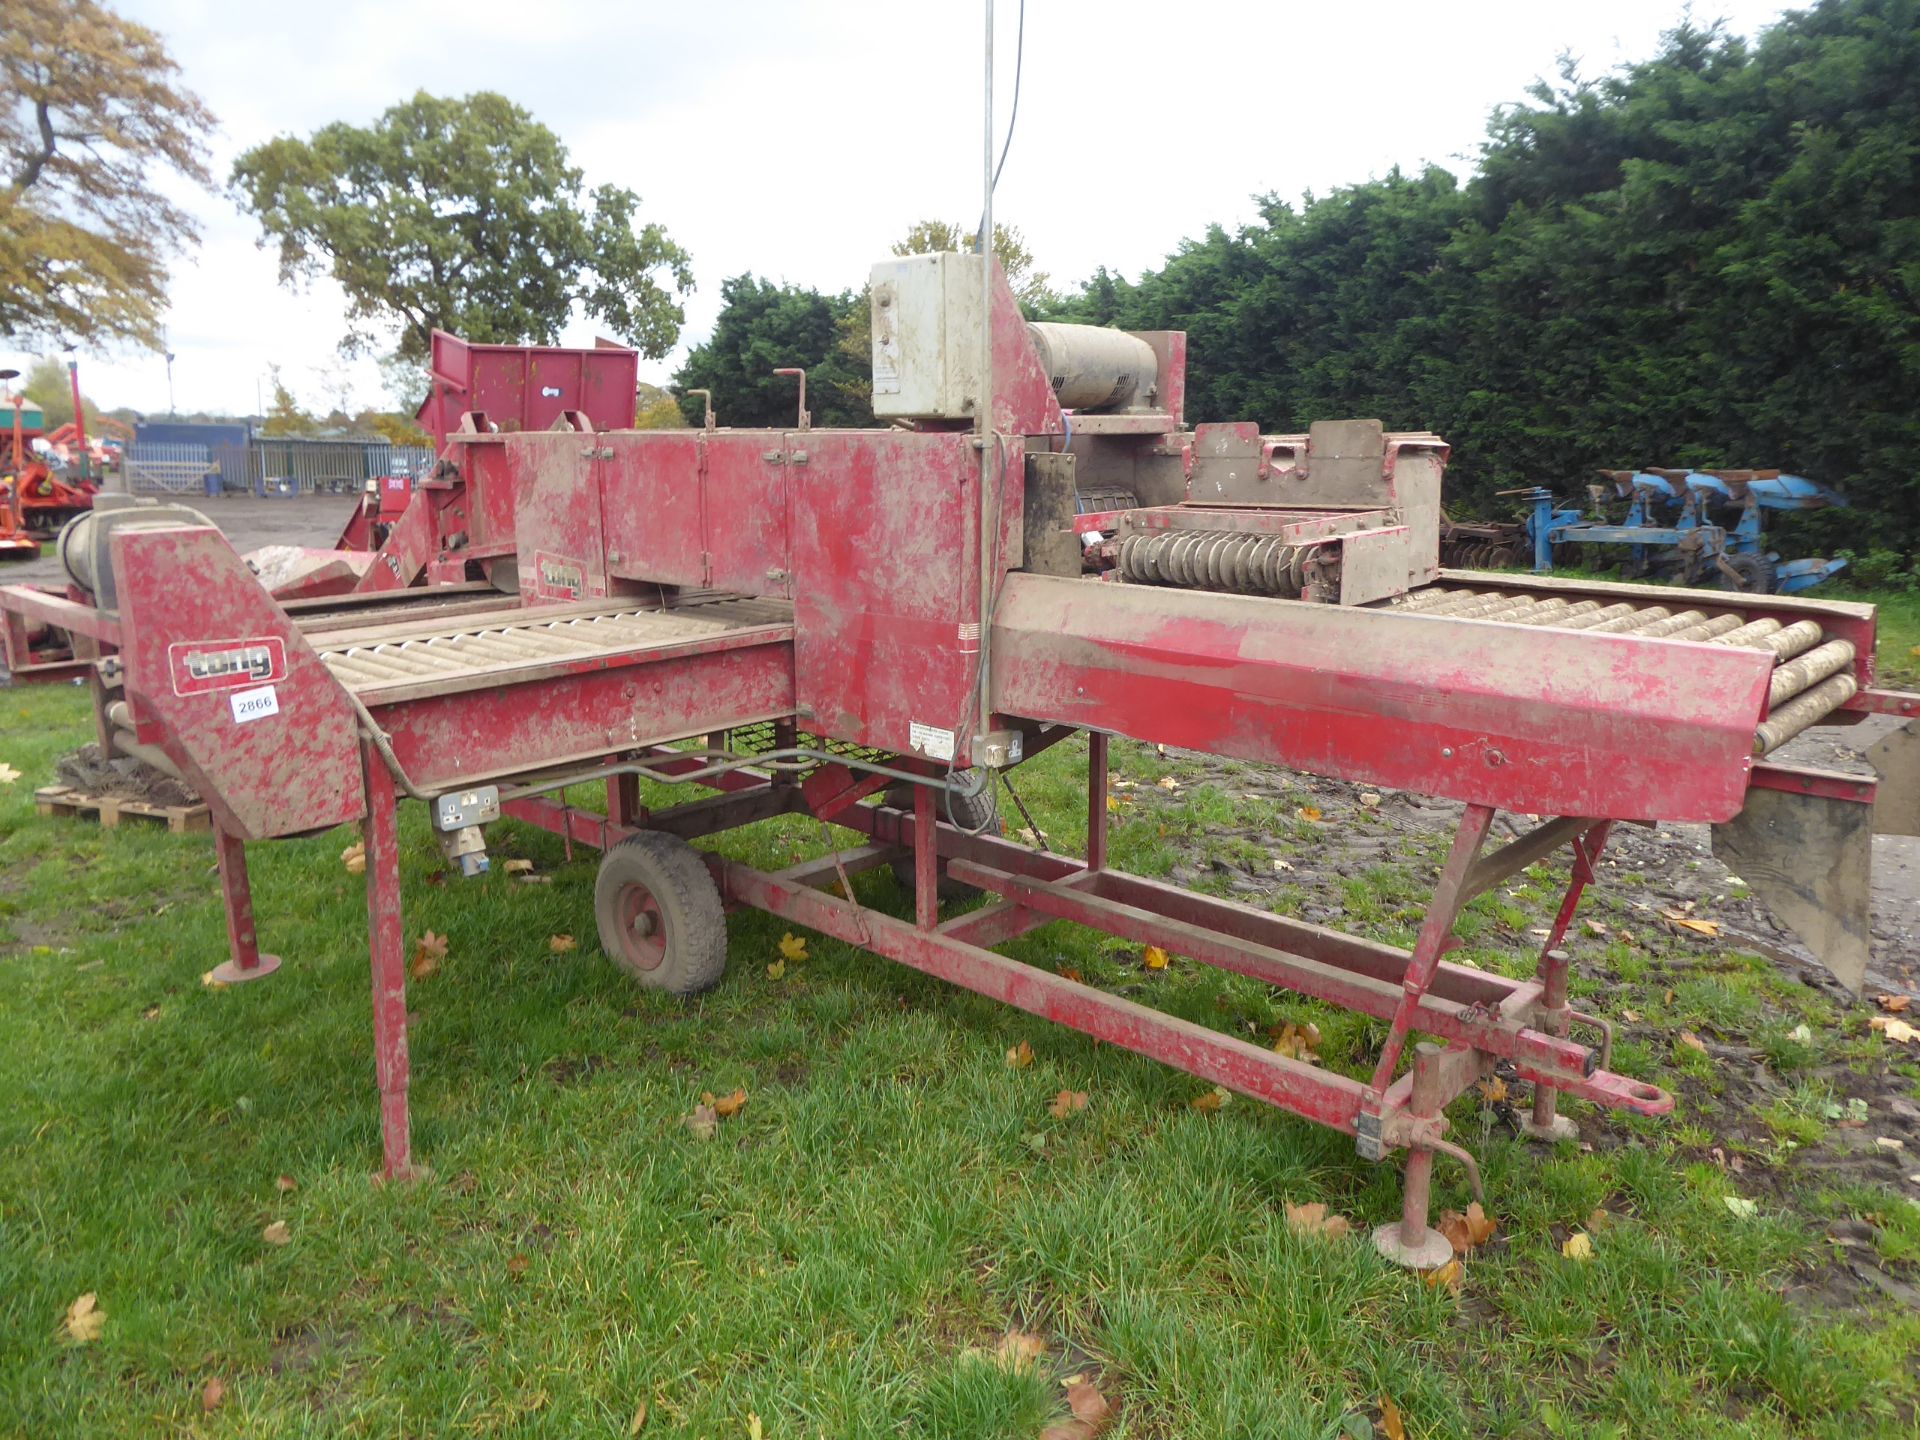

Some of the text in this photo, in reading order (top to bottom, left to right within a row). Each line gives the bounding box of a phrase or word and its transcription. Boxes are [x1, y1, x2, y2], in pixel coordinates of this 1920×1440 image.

[541, 560, 582, 599] tong
[183, 645, 272, 680] tong
[239, 697, 272, 713] 2866
